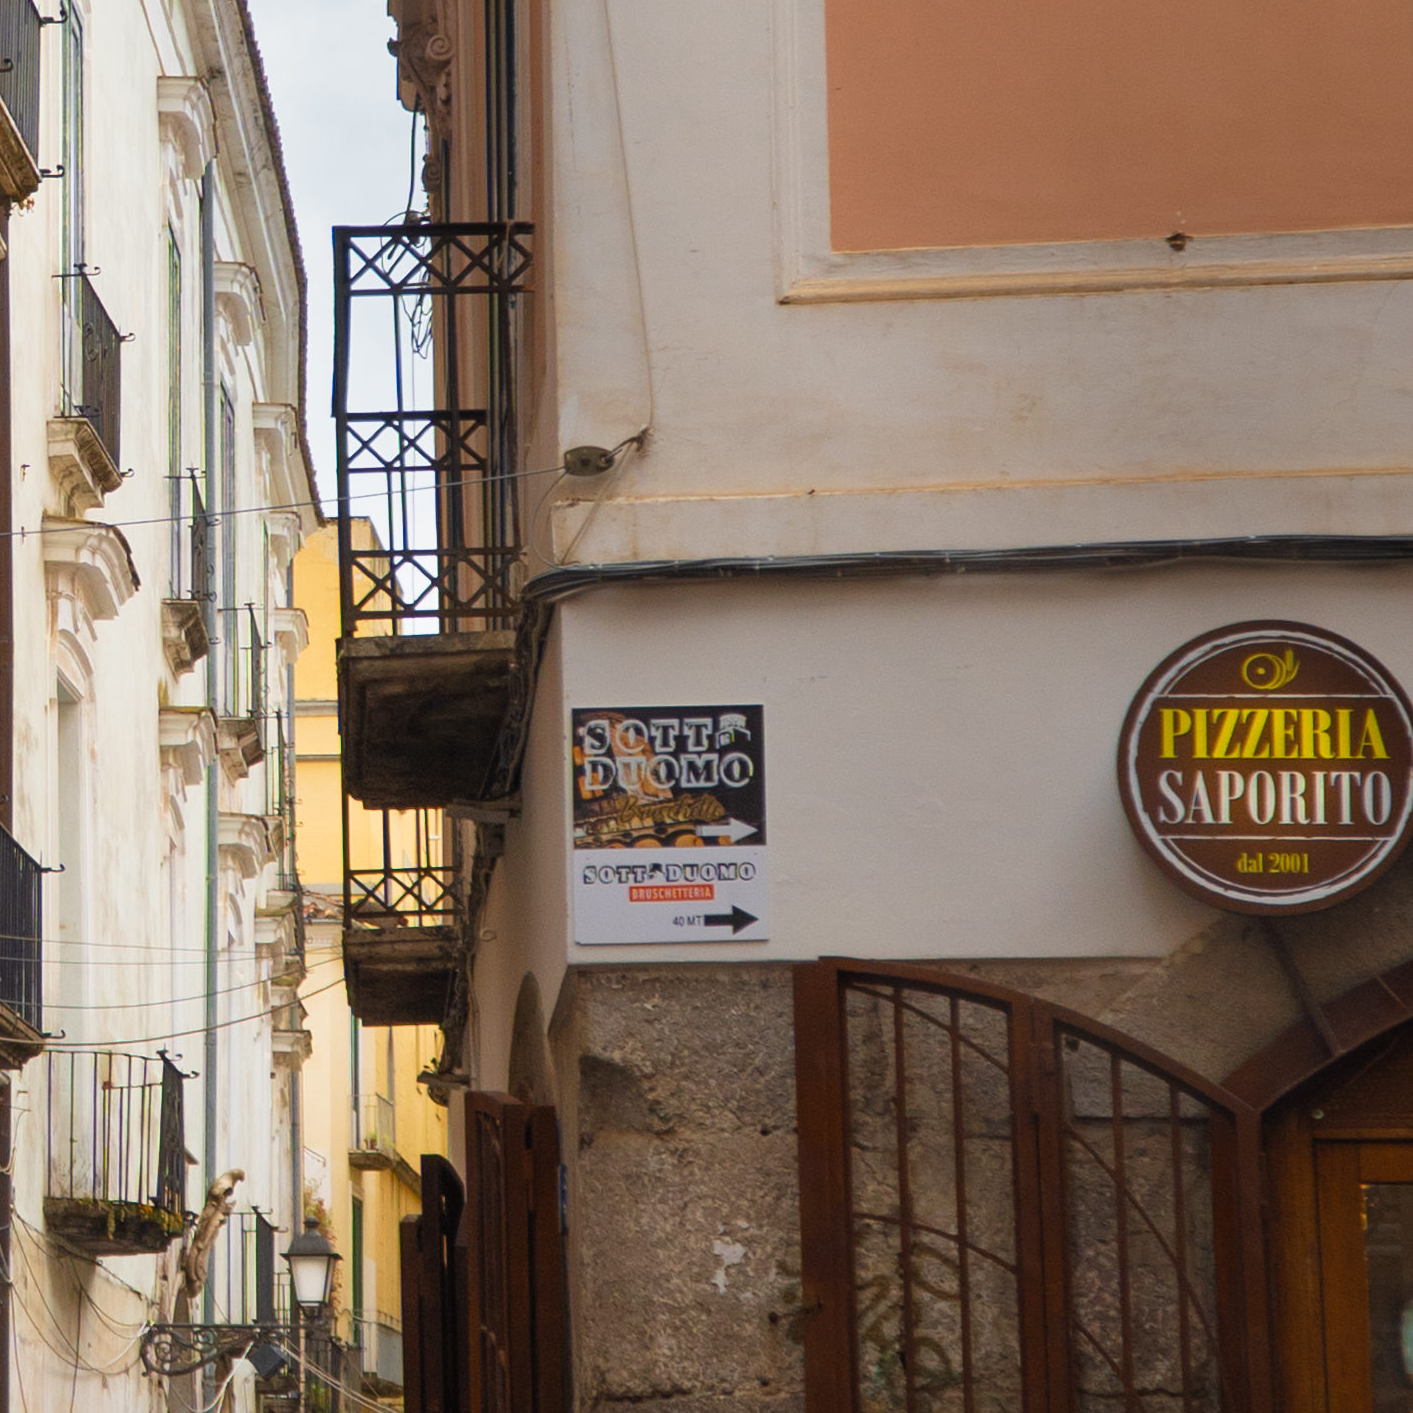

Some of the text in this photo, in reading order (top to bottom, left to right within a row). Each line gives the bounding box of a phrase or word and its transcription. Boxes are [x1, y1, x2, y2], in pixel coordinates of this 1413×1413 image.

[1158, 708, 1391, 759] PIZZERIA
[584, 752, 754, 790] DUOMO
[1158, 770, 1392, 826] SAPORITO
[1237, 853, 1310, 874] dal 2001
[632, 886, 712, 900] BRUSCHETTERIA
[672, 915, 703, 927] 40 MT
